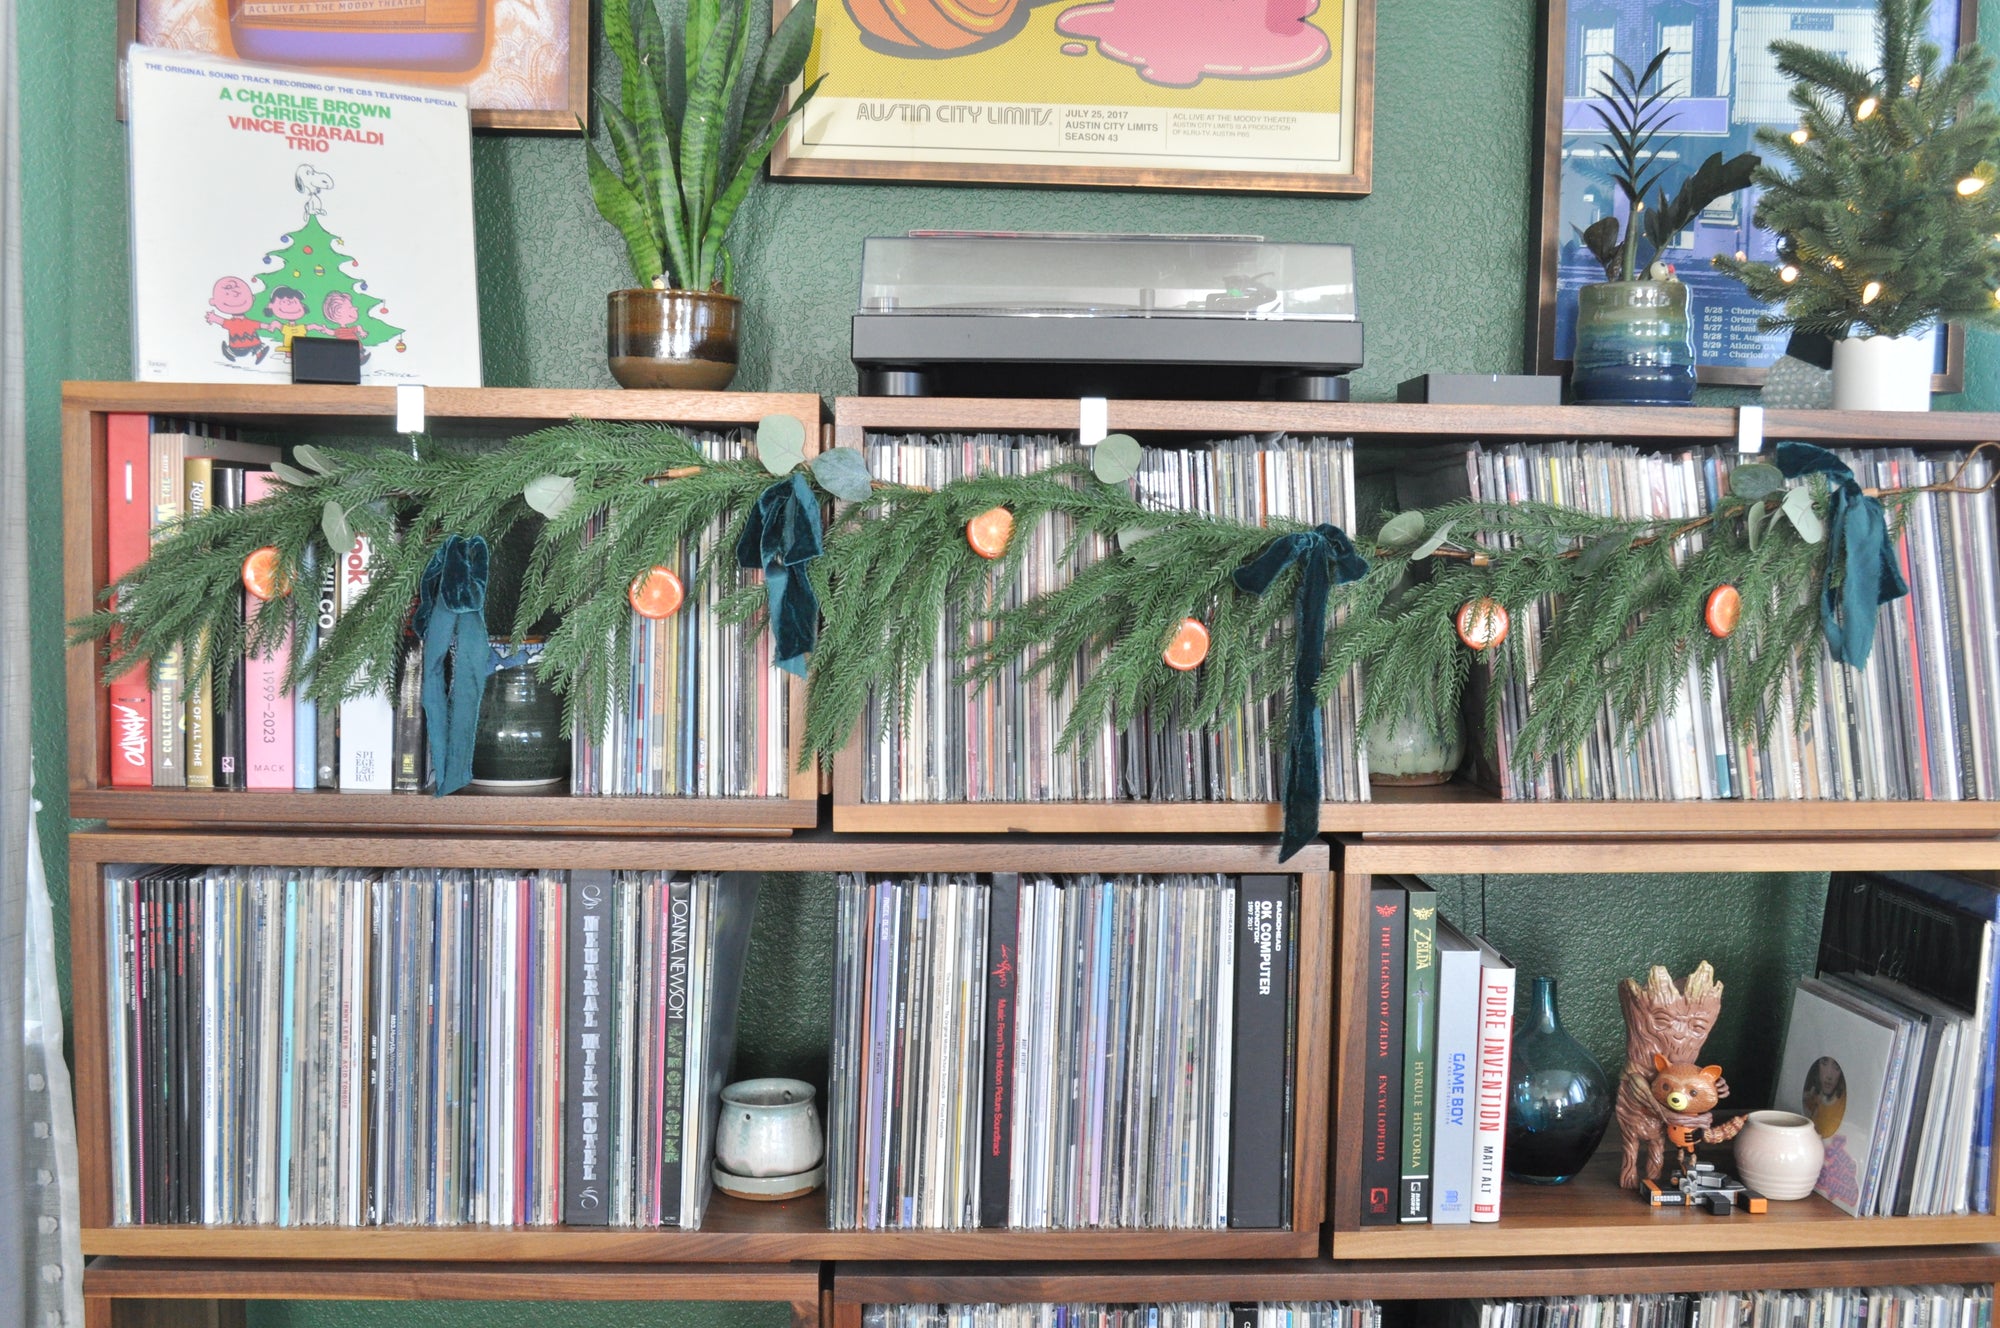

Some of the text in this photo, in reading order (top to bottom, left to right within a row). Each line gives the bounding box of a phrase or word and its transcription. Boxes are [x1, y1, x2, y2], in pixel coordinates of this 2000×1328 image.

[145, 62, 162, 71] THE
[165, 65, 206, 76] ORIGINAL
[208, 71, 240, 80] SOUND
[242, 75, 271, 84] TRACK
[273, 78, 322, 90] RECORDING
[356, 88, 372, 96] CBS
[375, 91, 422, 103] TELEVISION
[424, 97, 458, 108] SPECIAL
[219, 87, 391, 119] A CHARLIE BROWN
[228, 115, 384, 145] VINCE GUARALDI
[252, 104, 361, 129] CHRISTMAS
[856, 103, 1052, 126] AUSTIN CITY LIMITS
[1065, 109, 1128, 120] JULY 25, 2017
[1066, 121, 1159, 132] AUSTIN CITY LIMITS
[286, 136, 330, 153] TRIO
[1065, 132, 1118, 142] SEASON 43
[112, 704, 148, 766] MONDO
[162, 687, 172, 753] COLLECTION
[193, 706, 202, 766] OF ALL TIME
[254, 764, 285, 772] MACK
[881, 919, 889, 940] OLSEN
[1259, 900, 1272, 995] OK COMPUTER
[1414, 928, 1432, 970] ZELDA
[669, 896, 688, 1019] JOANNA NEWSOM
[997, 998, 1007, 1020] Music
[1379, 926, 1390, 1057] THE LEGEND OF ZELDA
[581, 915, 600, 1181] NEUTRAL MILK HOTEL
[996, 1023, 1006, 1042] From
[996, 1043, 1005, 1058] The
[996, 1059, 1004, 1084] Motion
[1479, 985, 1508, 1131] PURE INVENTION
[665, 1024, 683, 1163] HAVE ONE ON ME
[995, 1087, 1004, 1111] Picture
[1451, 1053, 1465, 1126] GAME BOY
[993, 1113, 1002, 1156] Soundtrack
[1376, 1075, 1388, 1162] ENCYCLOPEDIA
[1412, 1061, 1424, 1168] HYRULE HISTORIA
[1481, 1146, 1493, 1194] MATT ALT
